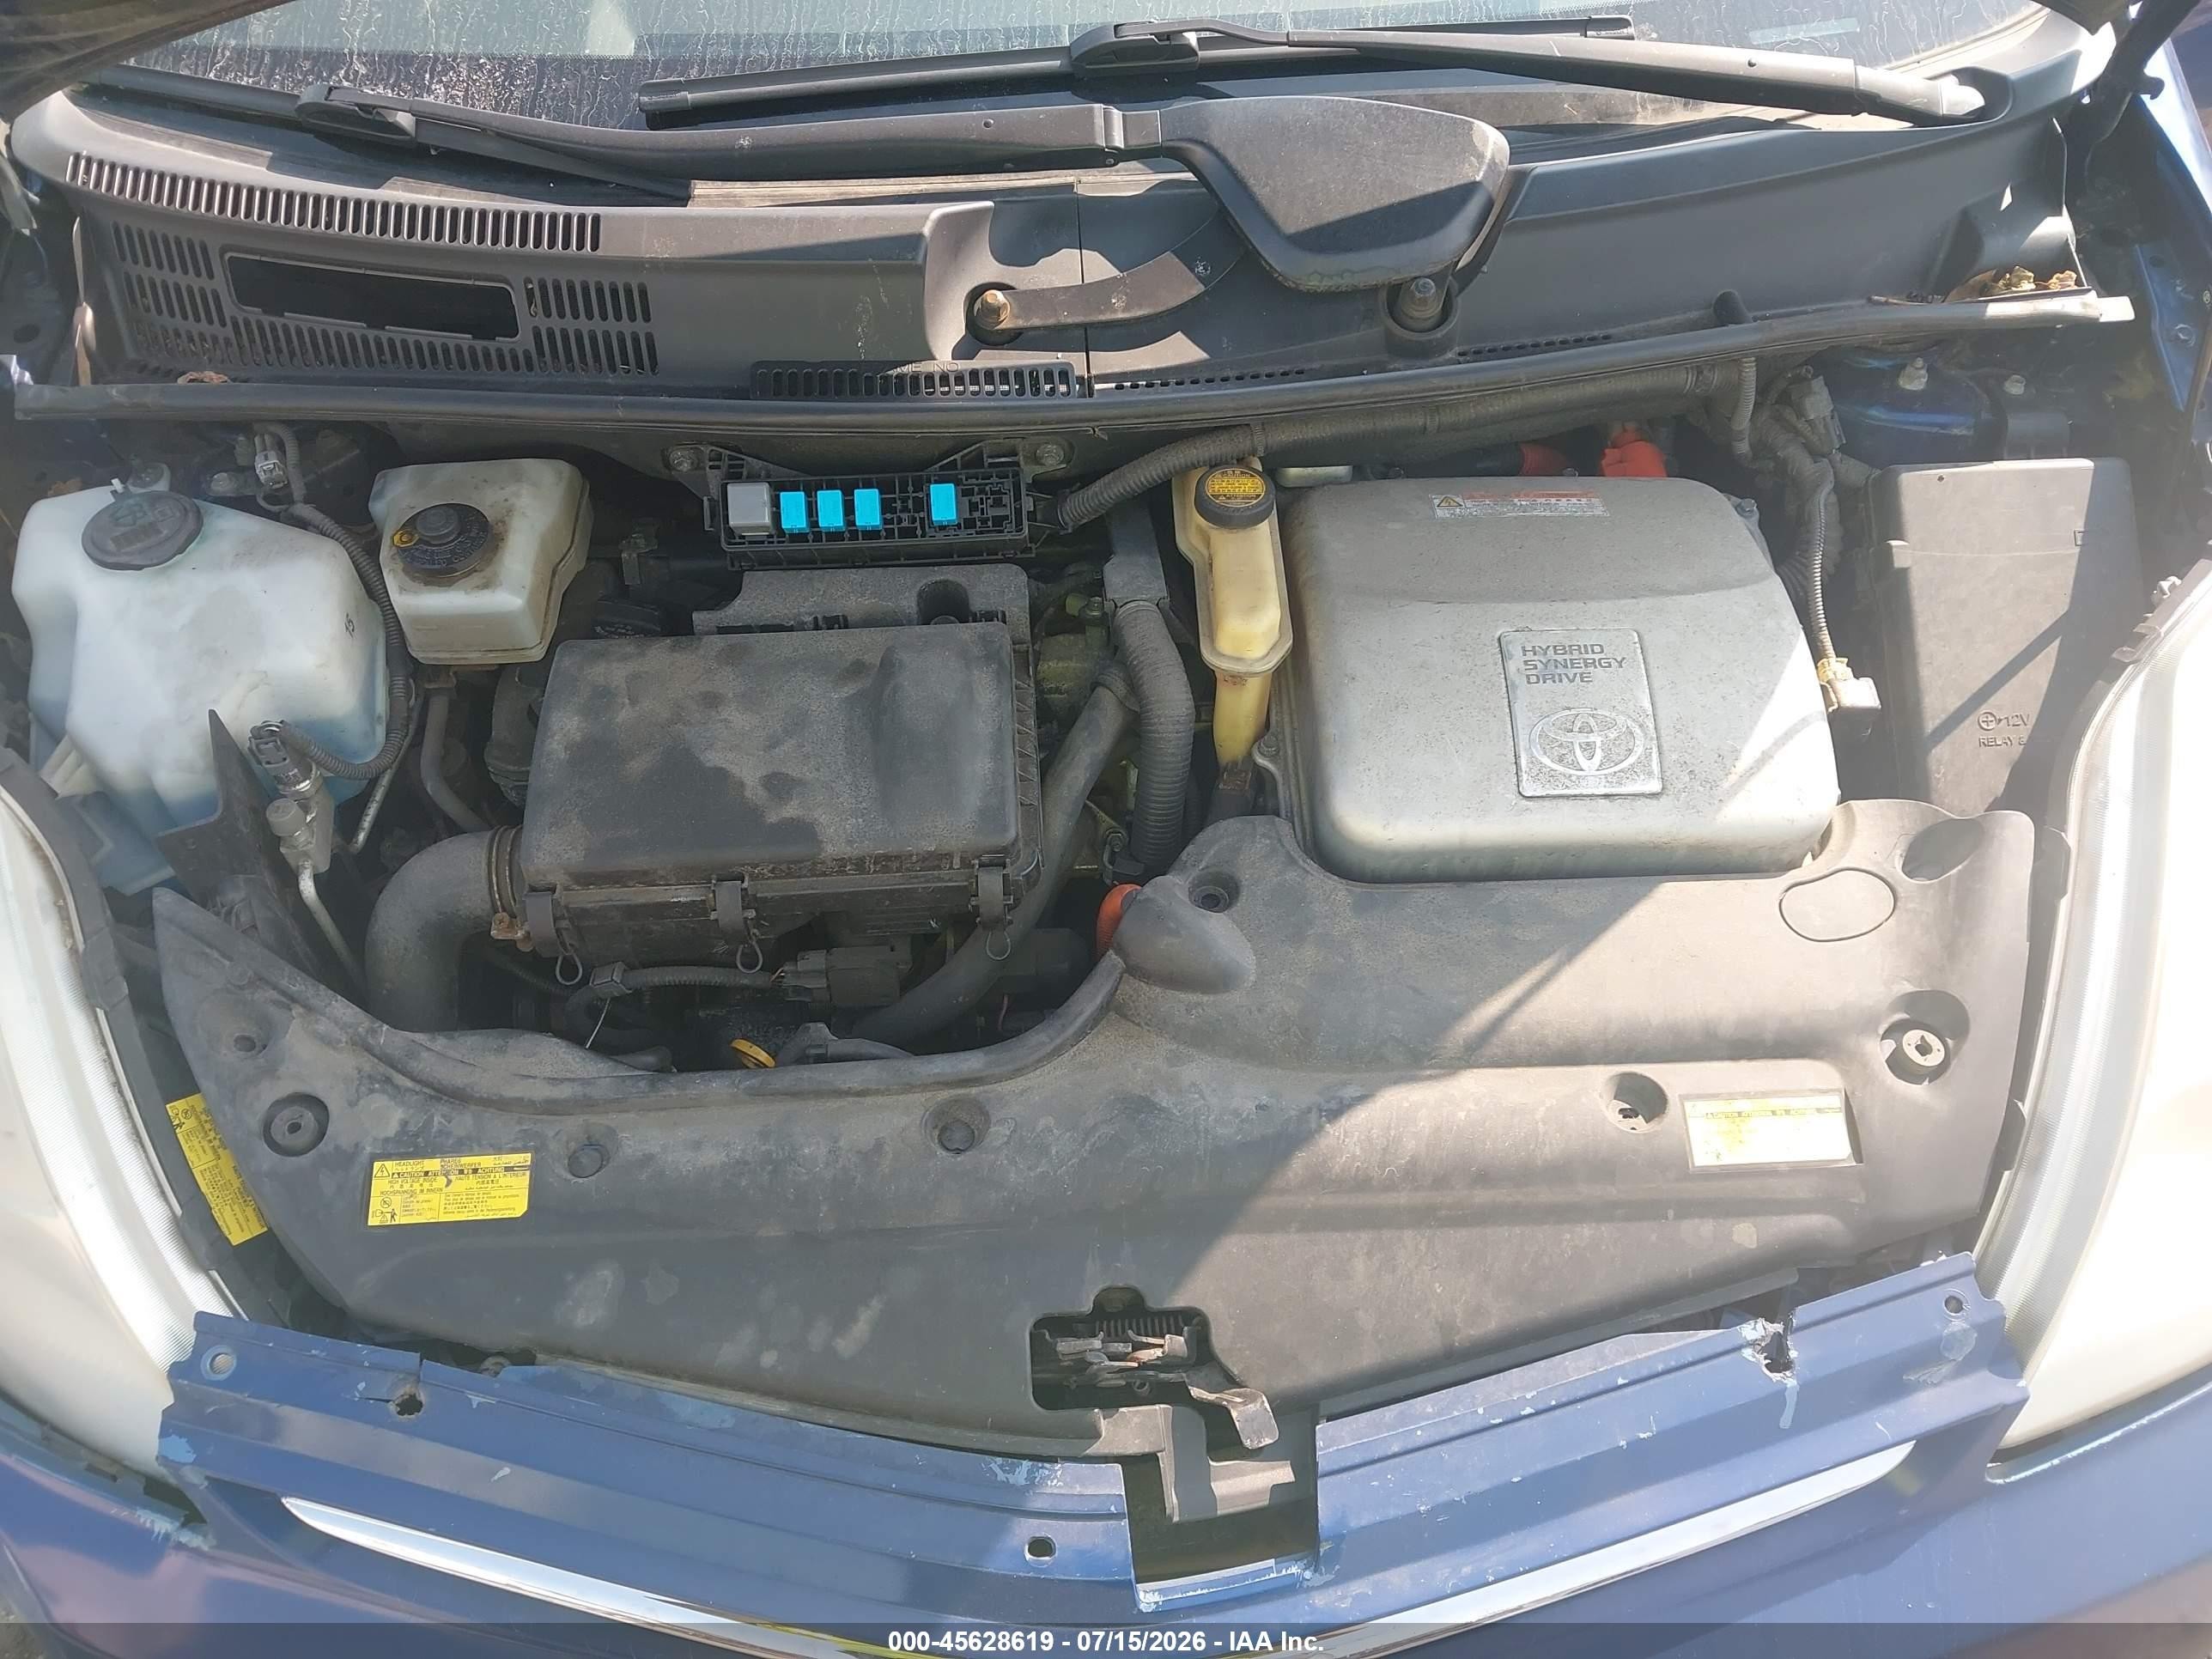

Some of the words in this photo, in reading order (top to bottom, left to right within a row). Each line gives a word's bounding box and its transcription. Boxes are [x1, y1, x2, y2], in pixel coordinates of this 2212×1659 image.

[933, 362, 959, 373] NO
[1521, 643, 1605, 657] HYBRID
[1522, 656, 1626, 672] SYNERGY
[1526, 672, 1594, 685] DRIVE
[1978, 737, 2014, 748] RELAY
